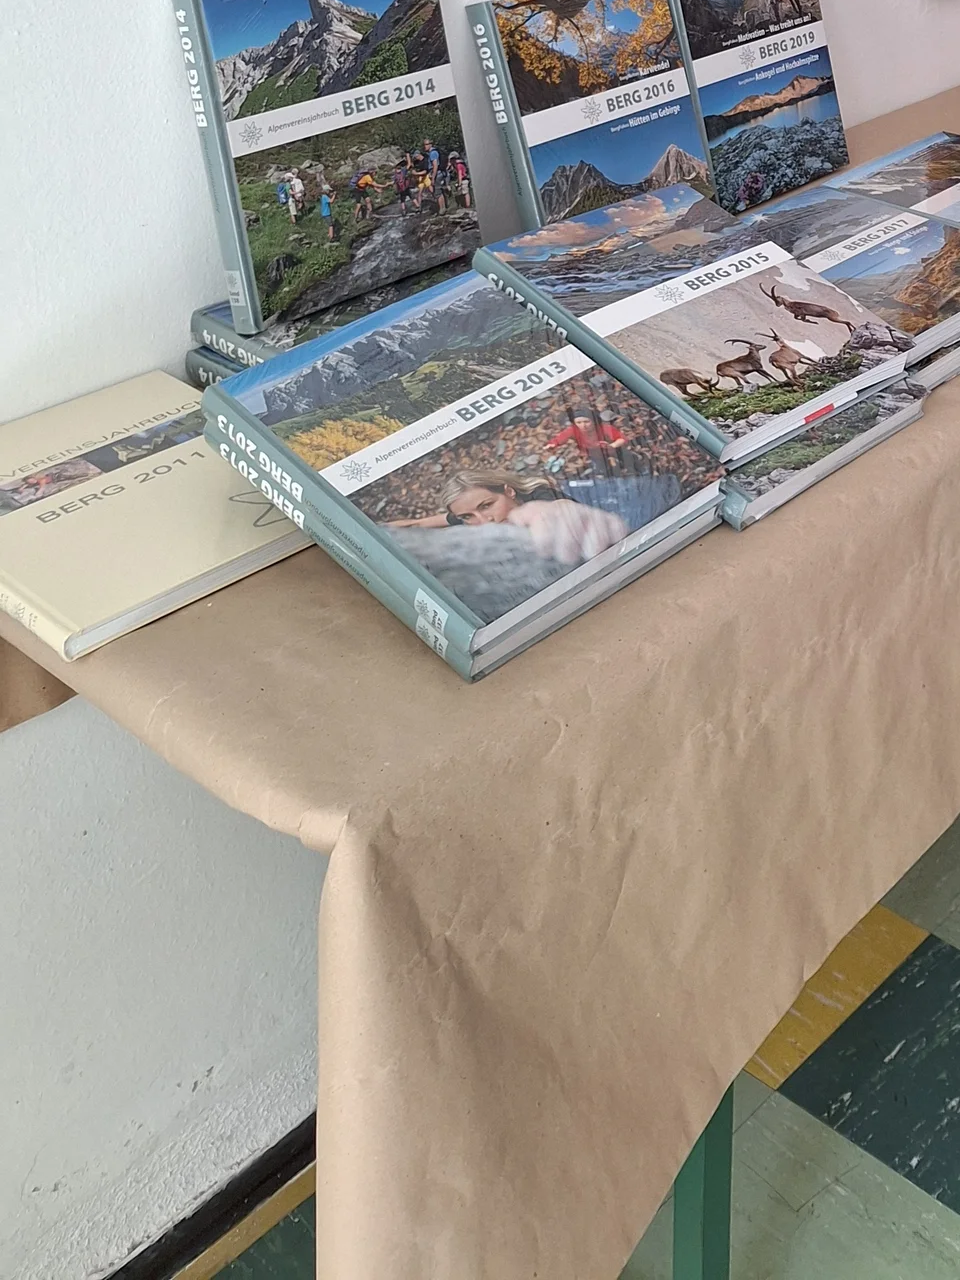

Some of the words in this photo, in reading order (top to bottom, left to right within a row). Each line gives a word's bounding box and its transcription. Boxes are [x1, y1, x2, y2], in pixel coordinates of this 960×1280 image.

[175, 9, 195, 64] 2014
[473, 23, 495, 70] 2016
[738, 28, 765, 42] Motivation
[769, 23, 780, 32] Was
[780, 19, 794, 29] treibt
[759, 40, 788, 59] BERG
[790, 31, 815, 49] 2019
[639, 60, 670, 76] Karwendel
[755, 68, 775, 81] Ankogel
[776, 64, 785, 73] und
[185, 67, 208, 128] BERG
[268, 107, 340, 135] Alpenvereinsjahrbuch
[341, 90, 391, 117] BERG
[394, 78, 437, 103] 2014
[486, 73, 508, 124] BERG
[606, 90, 642, 113] BERG
[644, 79, 675, 100] 2016
[629, 115, 650, 127] Hütten
[650, 111, 658, 120] im
[659, 104, 681, 117] Gebirge
[842, 233, 881, 251] BERG
[877, 219, 909, 235] 2017
[683, 265, 733, 291] BERG
[731, 251, 770, 274] 2015
[203, 330, 236, 358] 2014
[237, 347, 264, 367] RG
[199, 367, 222, 385] 014
[374, 417, 457, 464] Alpenvereinsjahrbuch
[455, 386, 518, 423] BERG
[515, 361, 568, 395] 2013
[0, 400, 202, 482] VEREINSJAHRBUC
[217, 415, 257, 459] 2013
[36, 483, 126, 523] BERG
[134, 451, 206, 484] 2011
[219, 443, 259, 487] 2013
[259, 452, 304, 503] BERG
[261, 480, 305, 530] BERG
